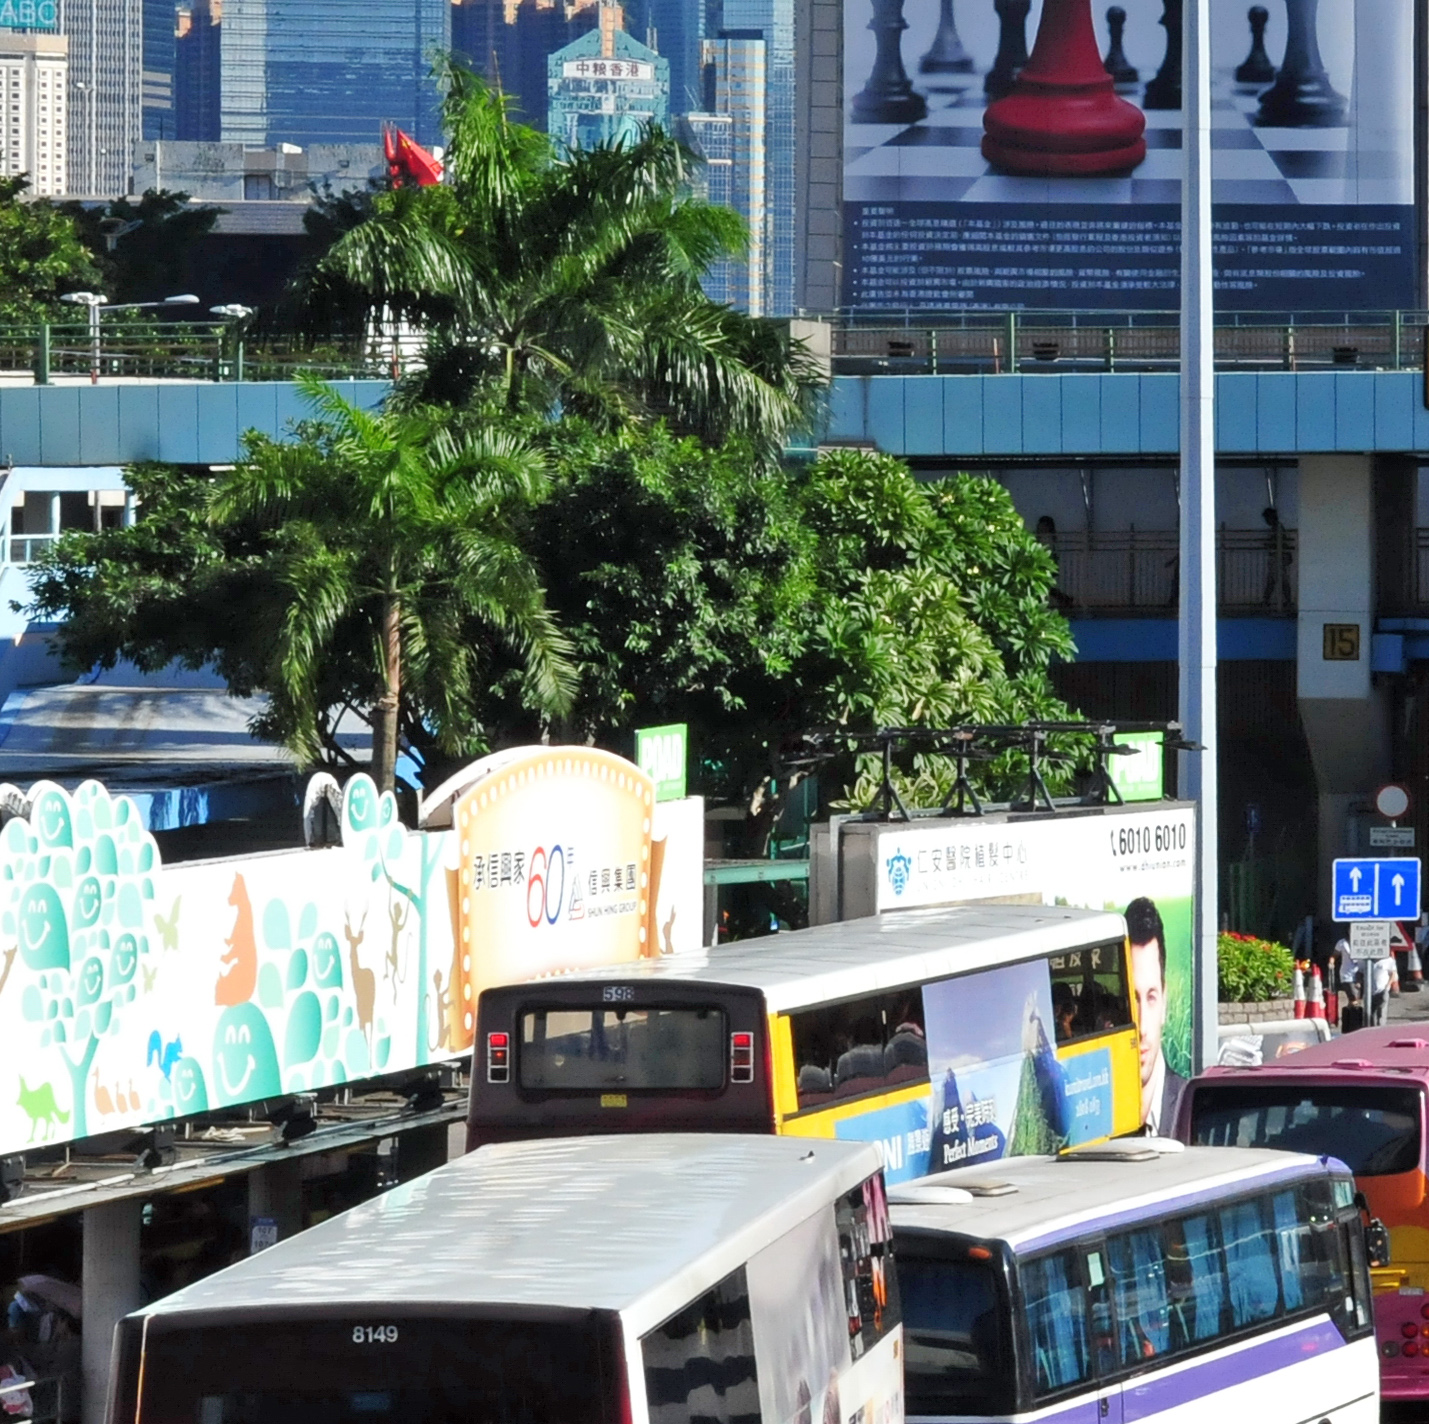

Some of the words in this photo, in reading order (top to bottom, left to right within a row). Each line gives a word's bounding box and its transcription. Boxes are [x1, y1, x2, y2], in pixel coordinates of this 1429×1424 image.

[1119, 827, 1151, 856] 6010
[1155, 823, 1186, 852] 6010
[352, 1326, 398, 1343] 8149
